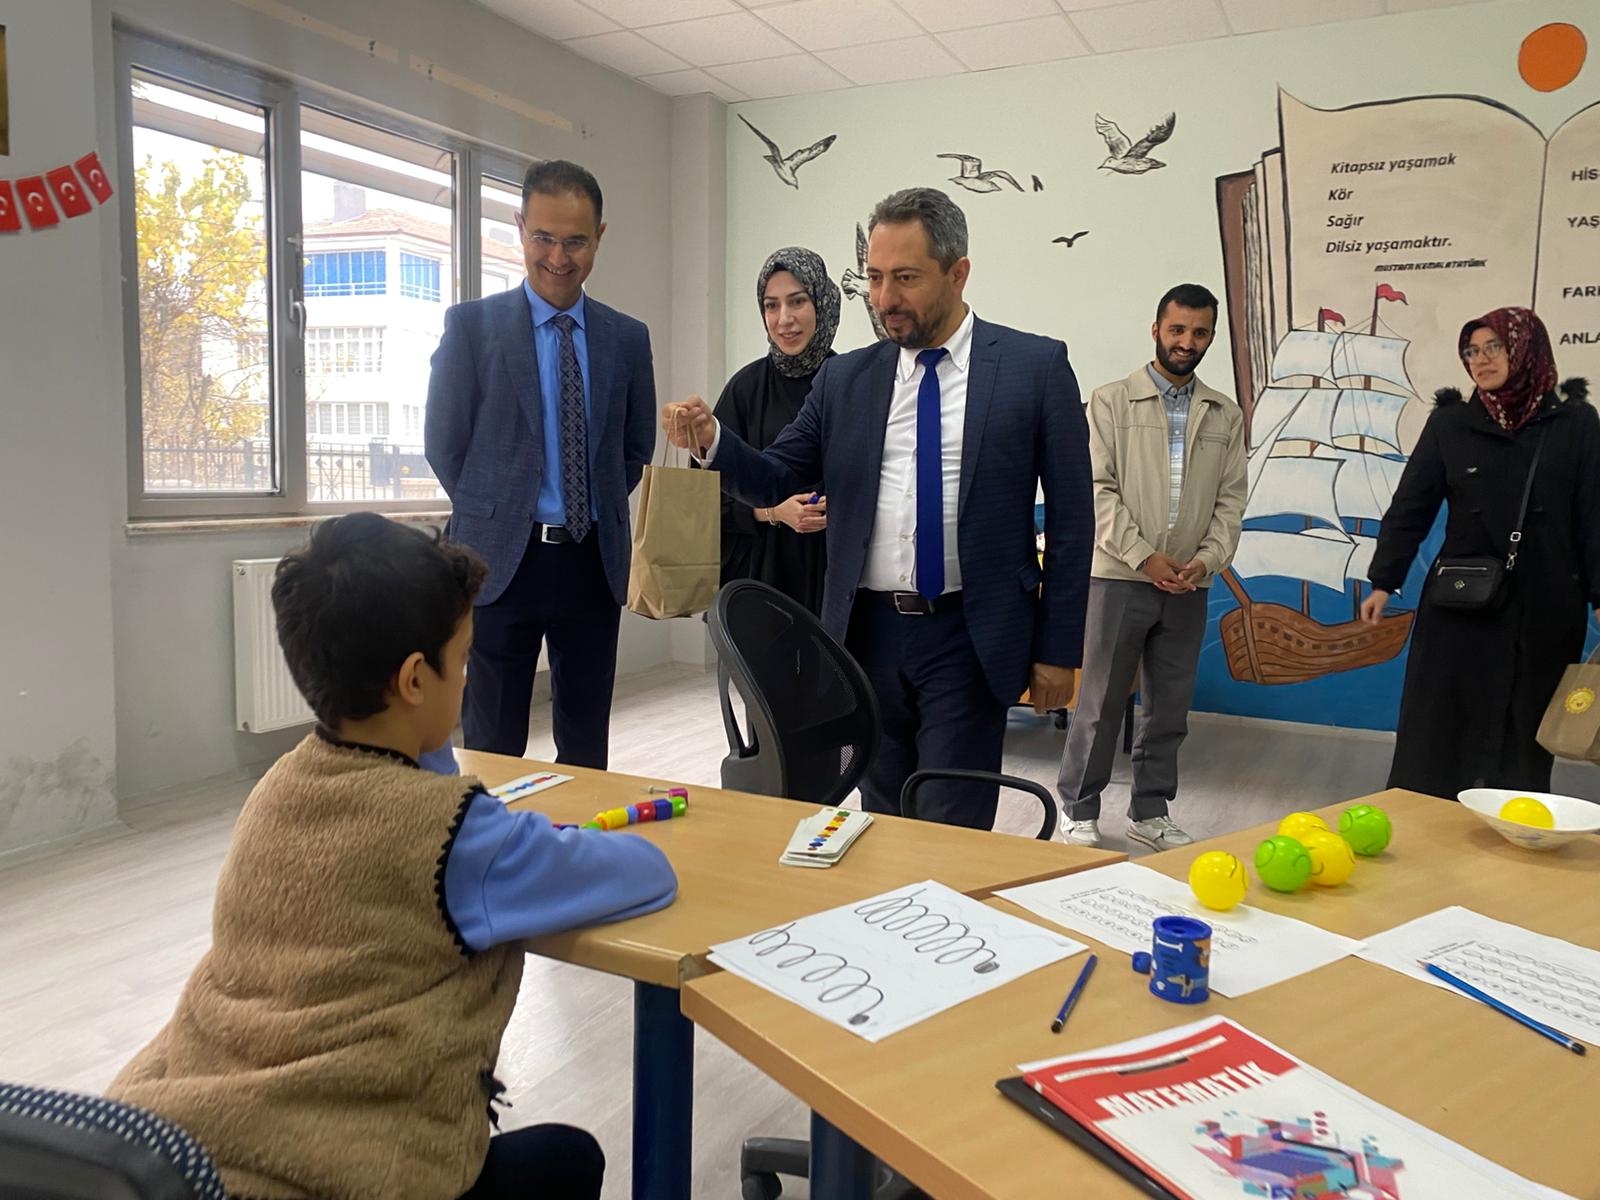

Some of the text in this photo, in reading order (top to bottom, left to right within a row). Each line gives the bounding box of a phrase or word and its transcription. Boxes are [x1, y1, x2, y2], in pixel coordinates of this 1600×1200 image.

[1331, 152, 1457, 174] Kitapsız yaşamak
[1328, 188, 1354, 201] Kör
[1326, 214, 1364, 229] Sağır
[1567, 215, 1600, 229] YAŞ
[1326, 235, 1452, 254] Dilsiz yaşamaktır.
[1095, 1060, 1274, 1118] MATEMATİK
